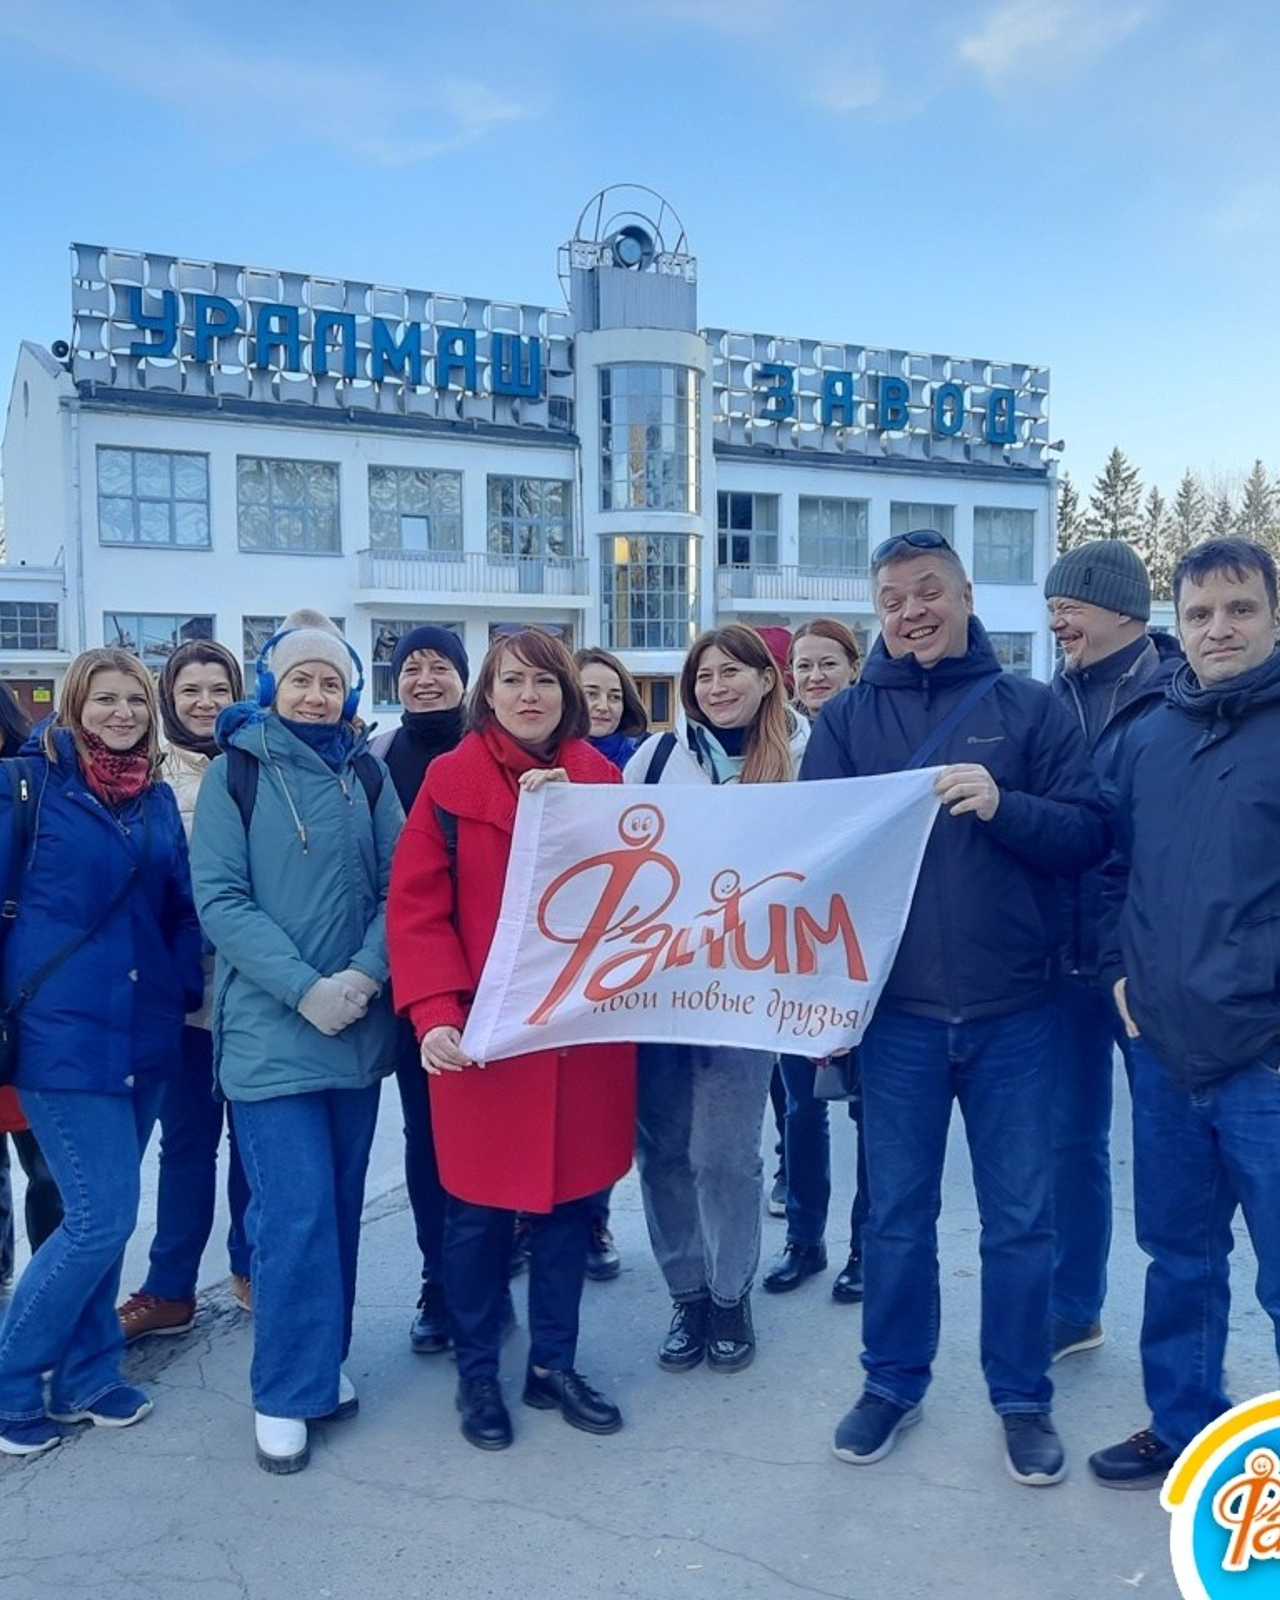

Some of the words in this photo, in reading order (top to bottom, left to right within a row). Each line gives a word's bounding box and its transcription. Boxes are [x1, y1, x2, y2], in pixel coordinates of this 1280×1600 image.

[129, 285, 541, 398] УРАЛМАШ
[755, 362, 1018, 444] ЗАВОД
[671, 979, 757, 1015] новые
